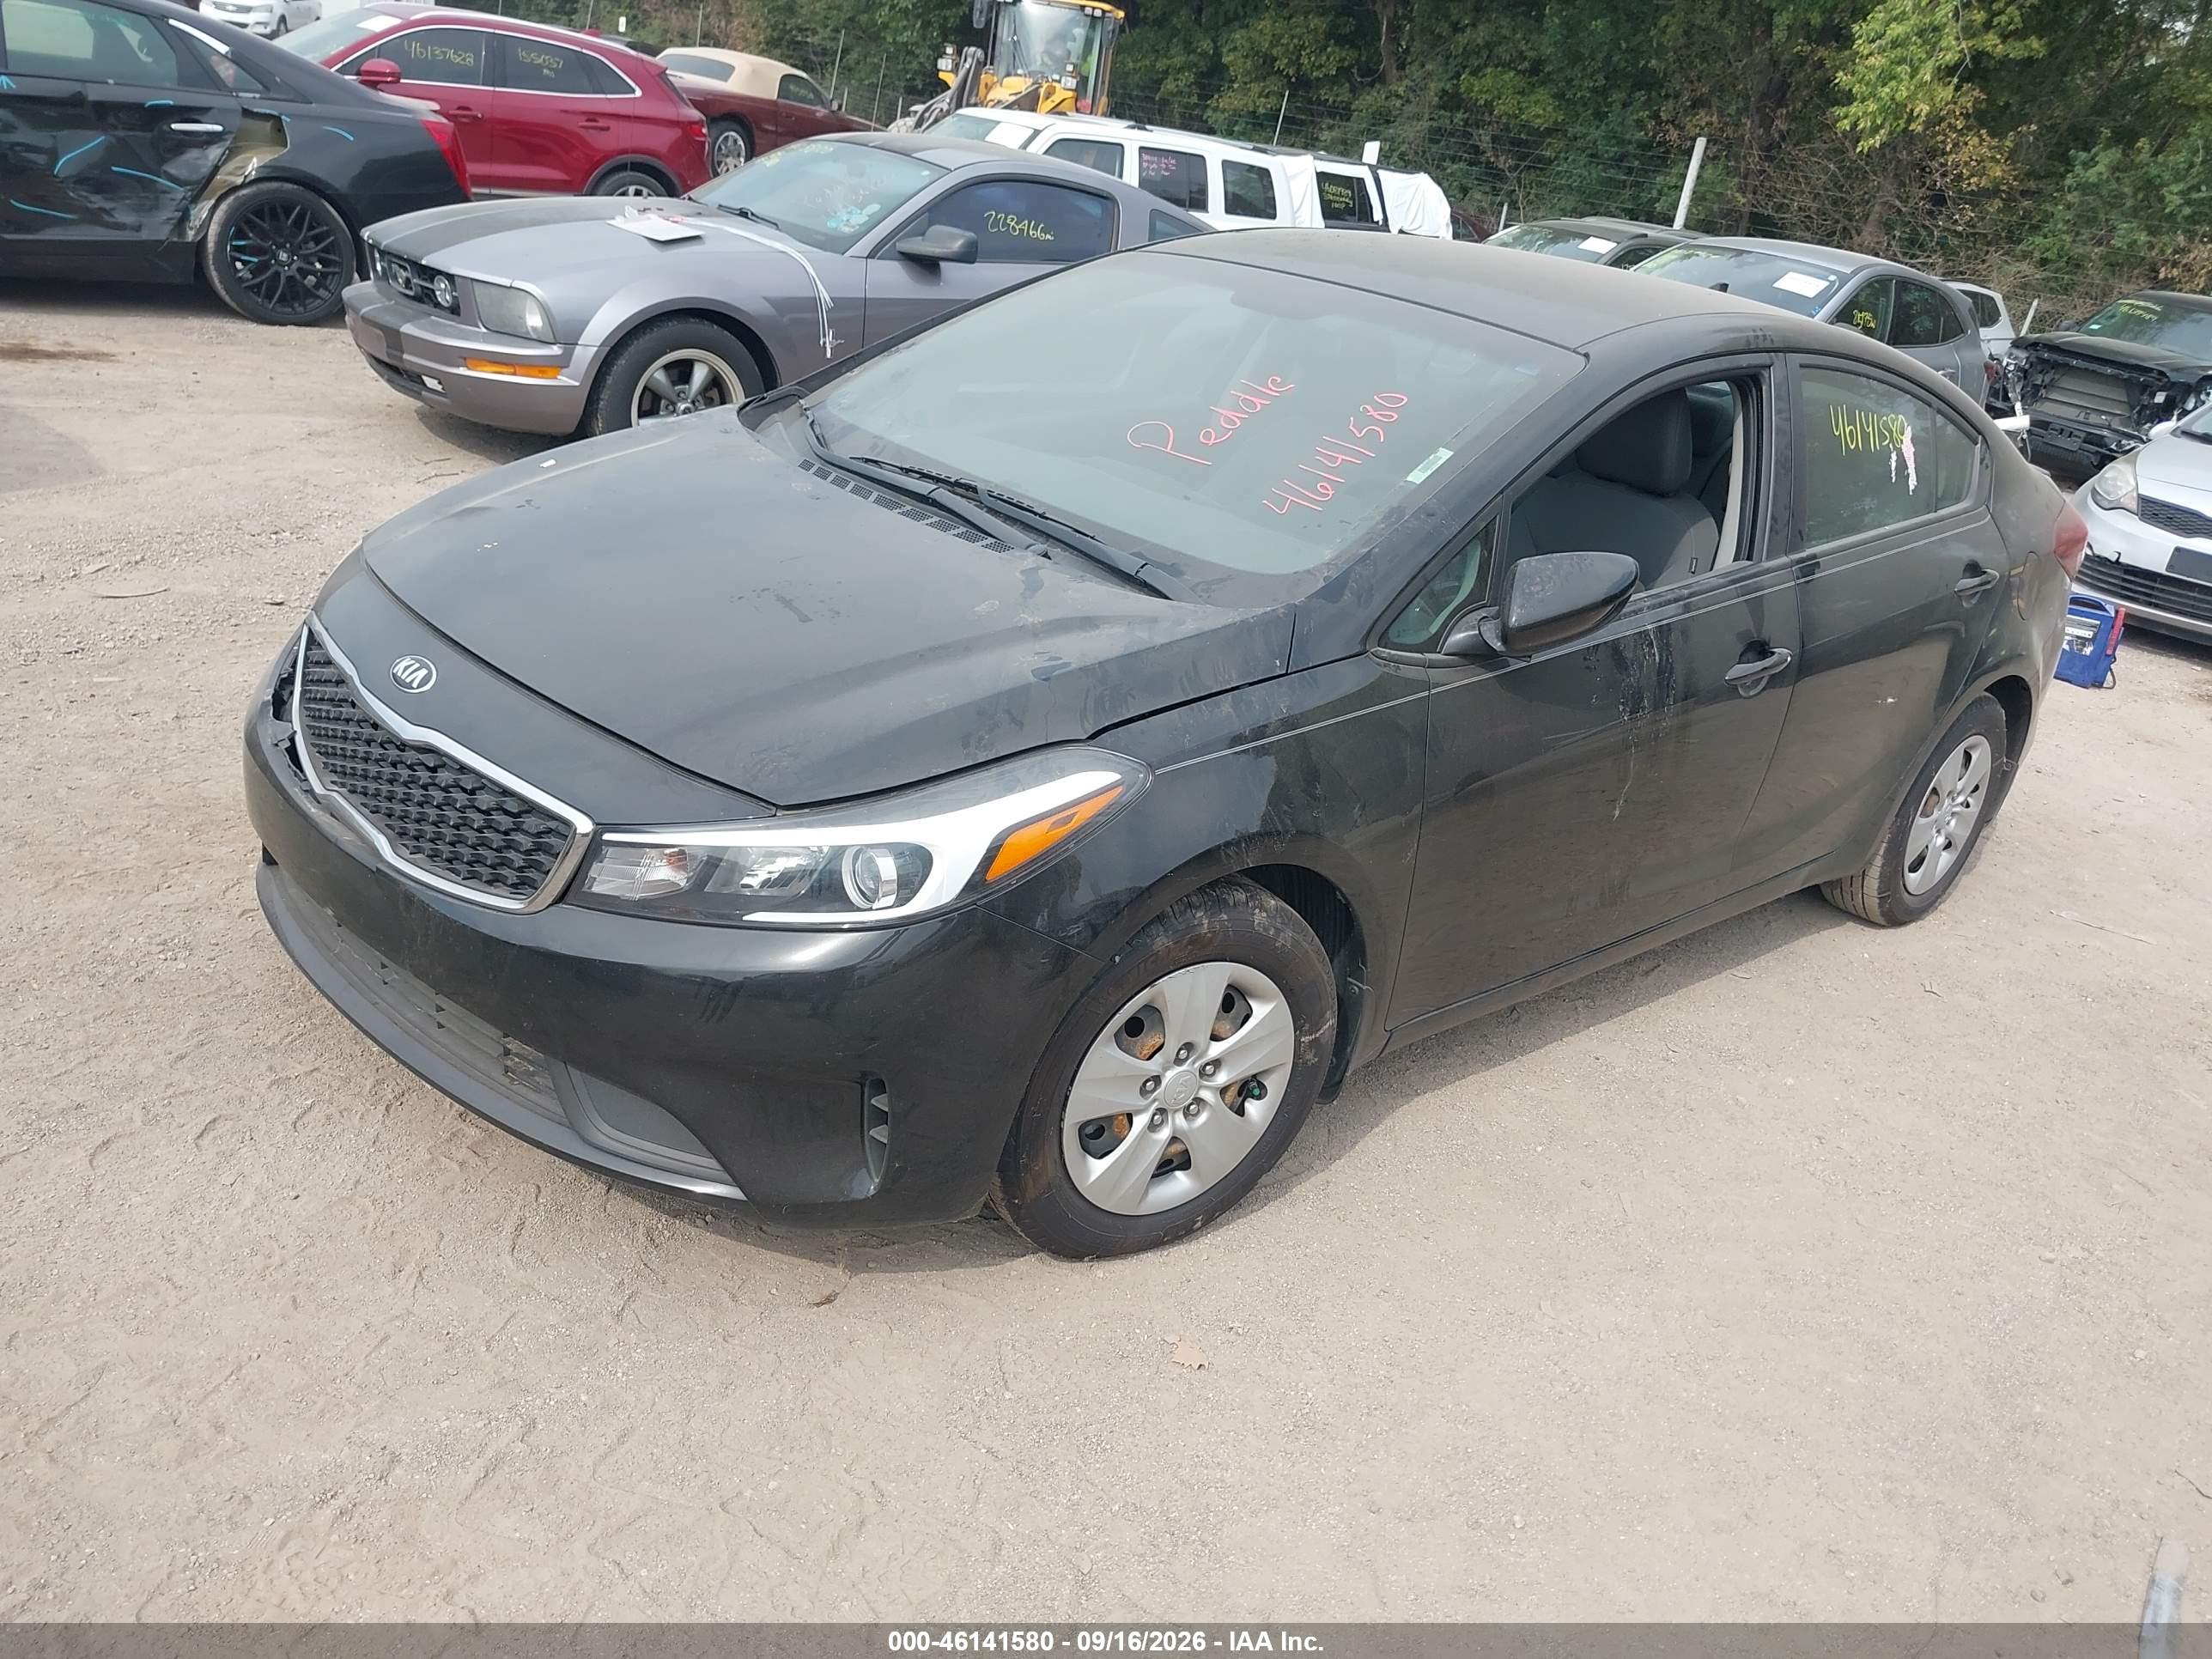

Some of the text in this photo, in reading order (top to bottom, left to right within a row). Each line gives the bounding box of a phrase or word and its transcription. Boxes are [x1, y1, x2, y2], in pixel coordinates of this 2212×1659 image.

[404, 40, 475, 67] 46137628
[1127, 376, 1295, 465] Peddle
[1262, 392, 1408, 514] 46141580
[392, 658, 428, 689] KIA
